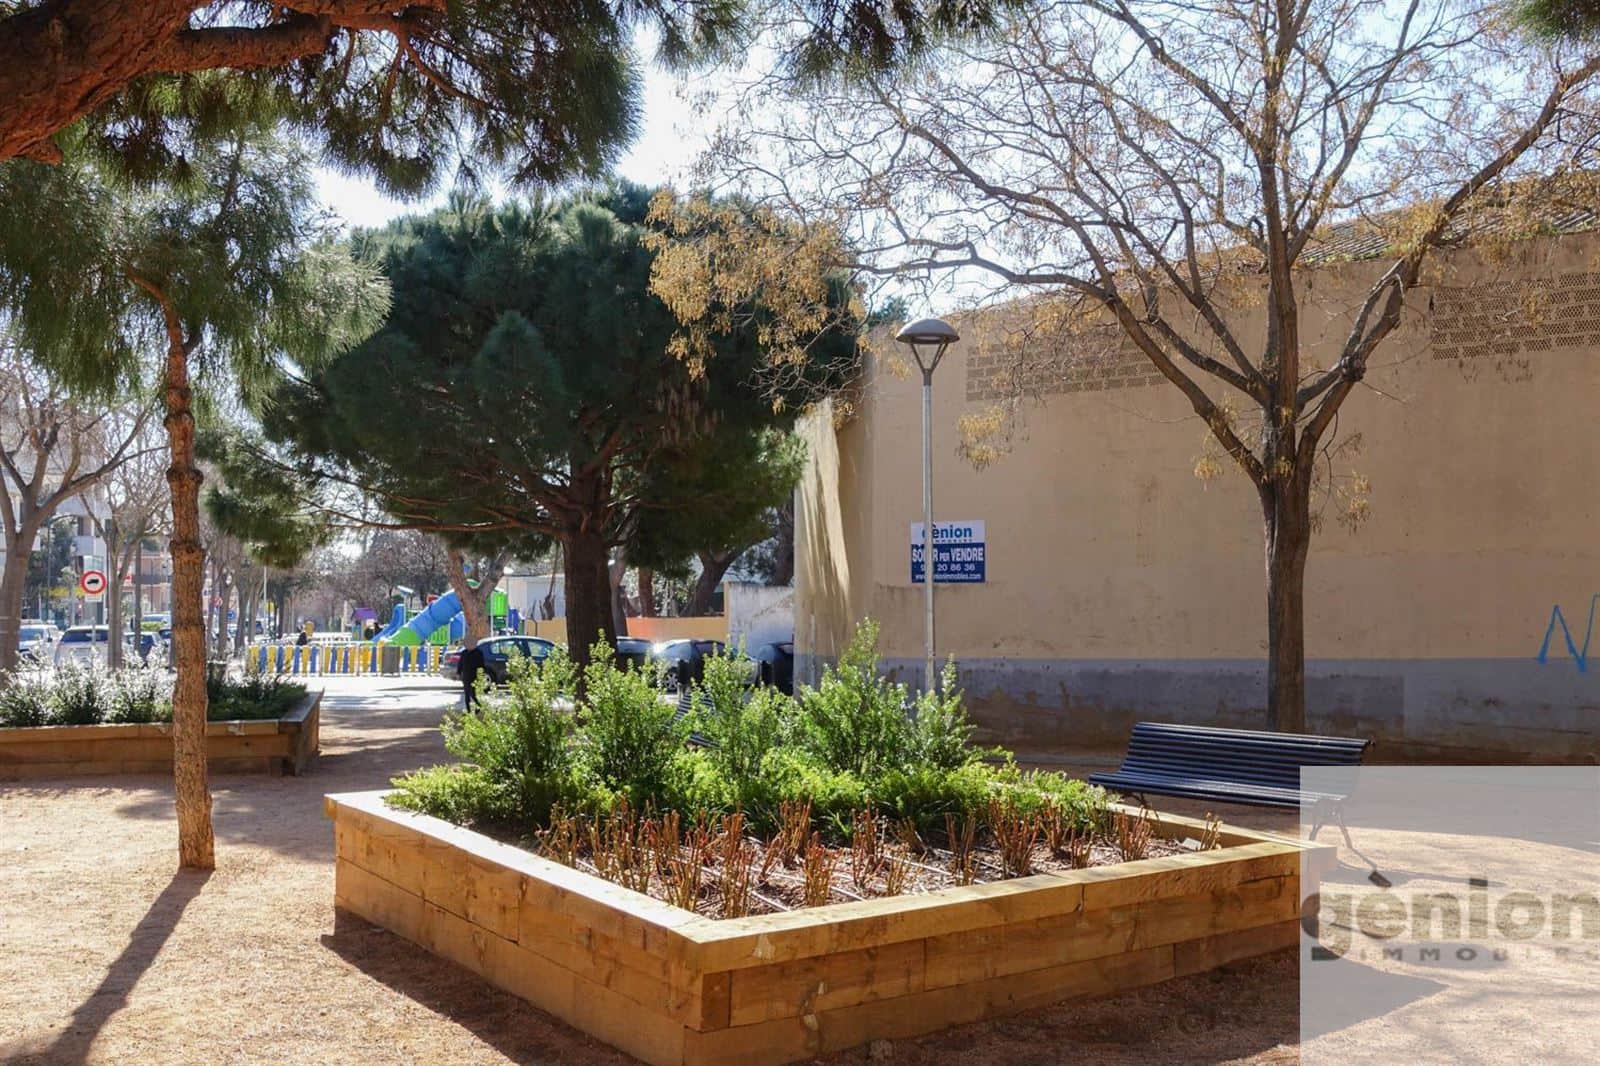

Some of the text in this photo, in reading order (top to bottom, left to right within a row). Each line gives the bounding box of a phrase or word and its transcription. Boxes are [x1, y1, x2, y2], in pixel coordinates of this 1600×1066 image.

[921, 524, 973, 538] ènion
[912, 548, 939, 562] SOR
[950, 547, 984, 561] VENDRE
